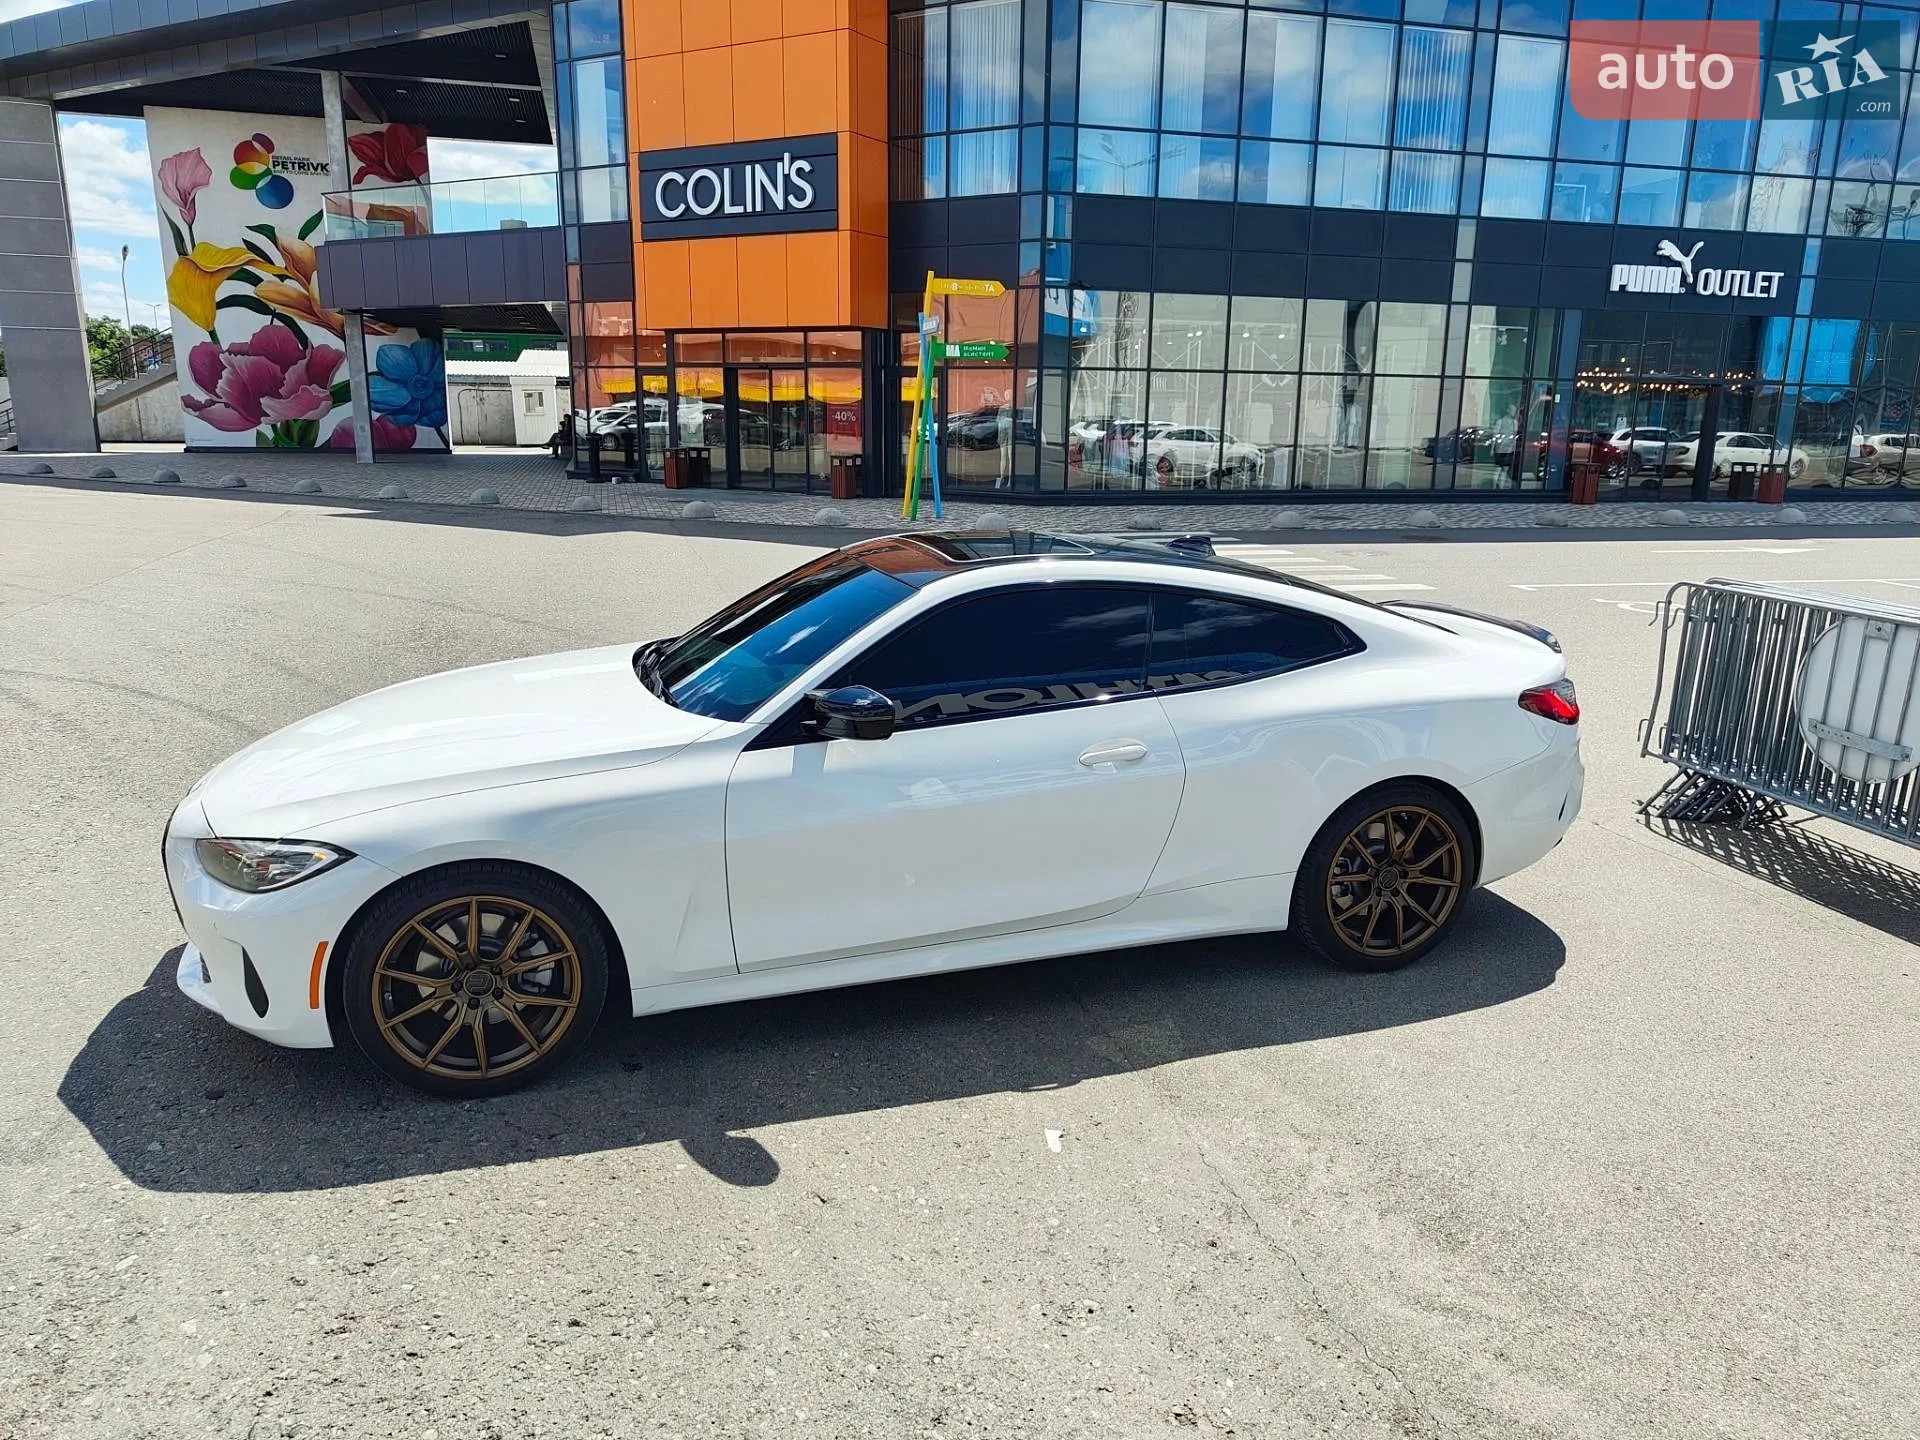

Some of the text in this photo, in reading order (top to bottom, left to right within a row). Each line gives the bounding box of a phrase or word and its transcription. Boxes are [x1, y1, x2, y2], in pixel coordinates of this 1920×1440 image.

[655, 152, 814, 218] COLIN'S
[1609, 264, 1784, 298] PUMA OUTLET
[831, 411, 857, 422] -40%
